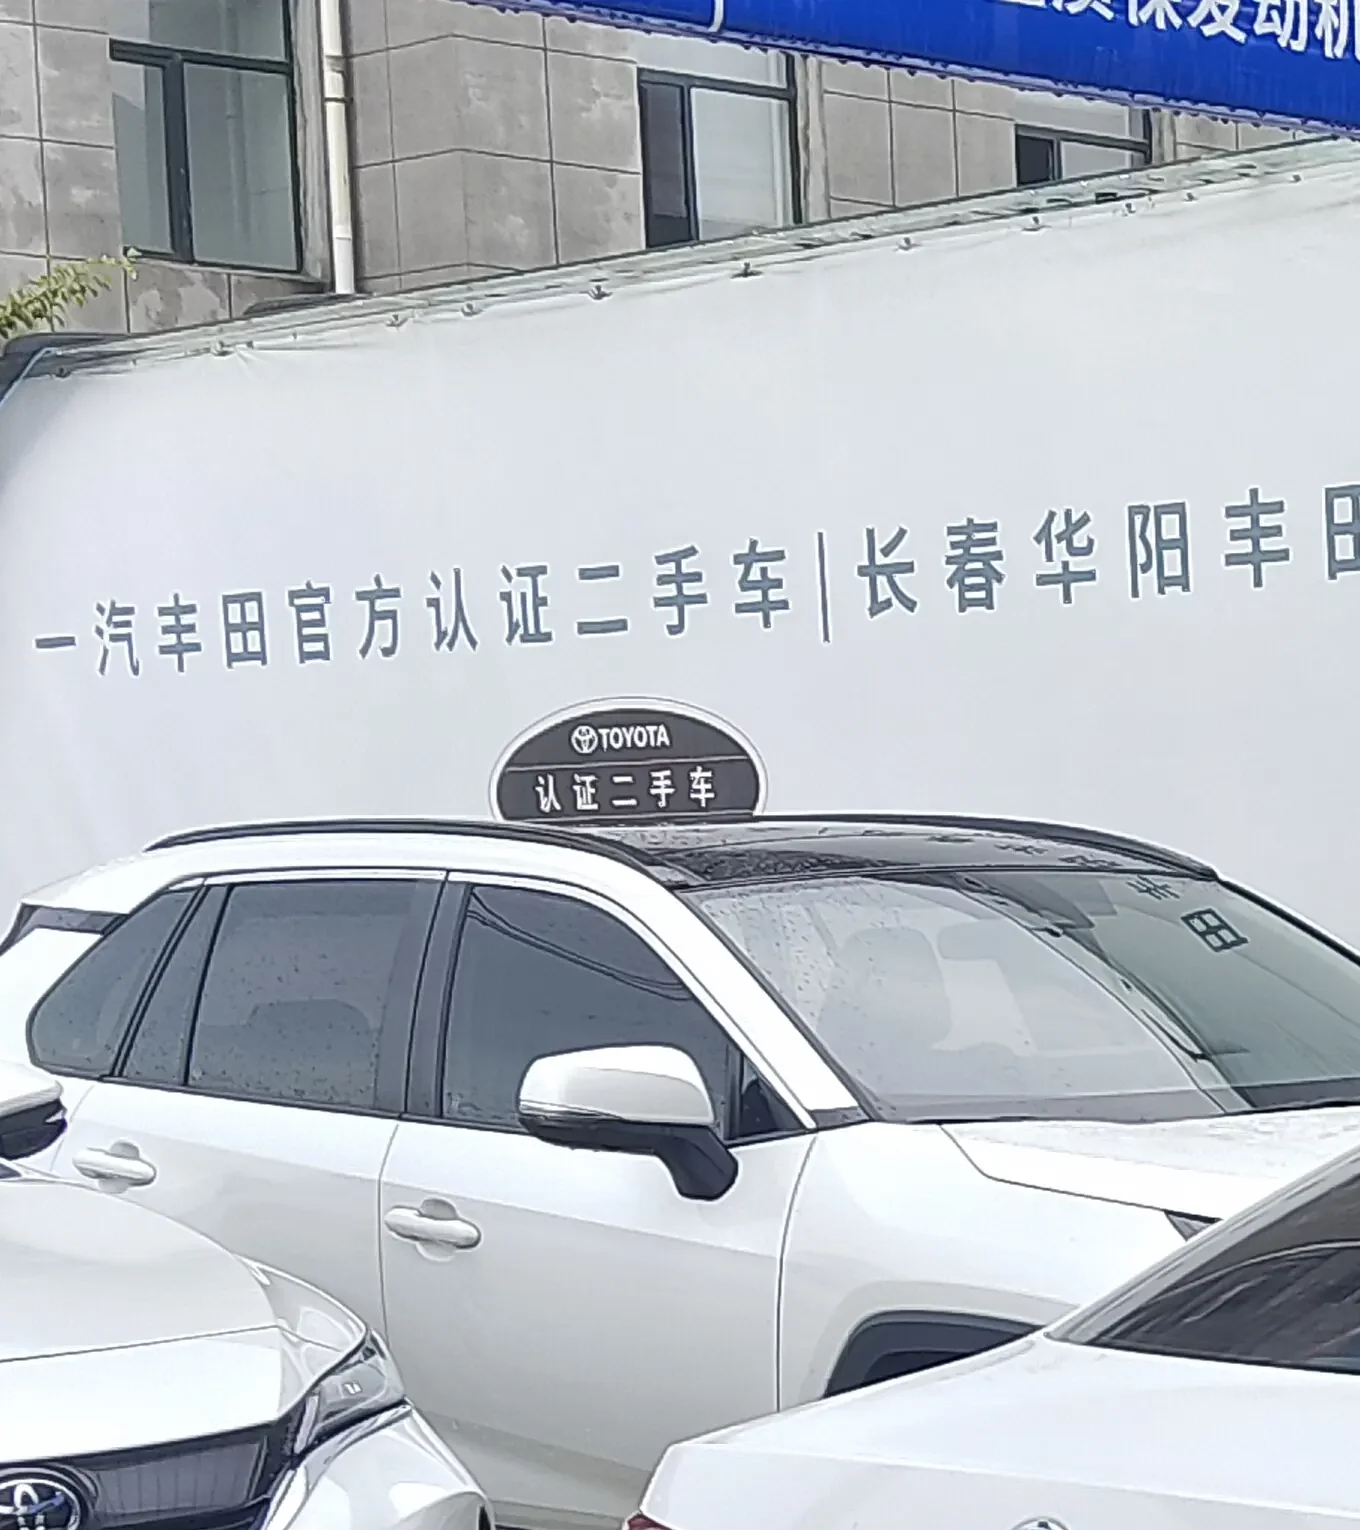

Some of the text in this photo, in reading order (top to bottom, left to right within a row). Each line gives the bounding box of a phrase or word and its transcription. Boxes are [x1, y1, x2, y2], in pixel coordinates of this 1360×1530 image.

[598, 724, 671, 752] TOYOTA
[534, 765, 716, 814] 认证二手车
